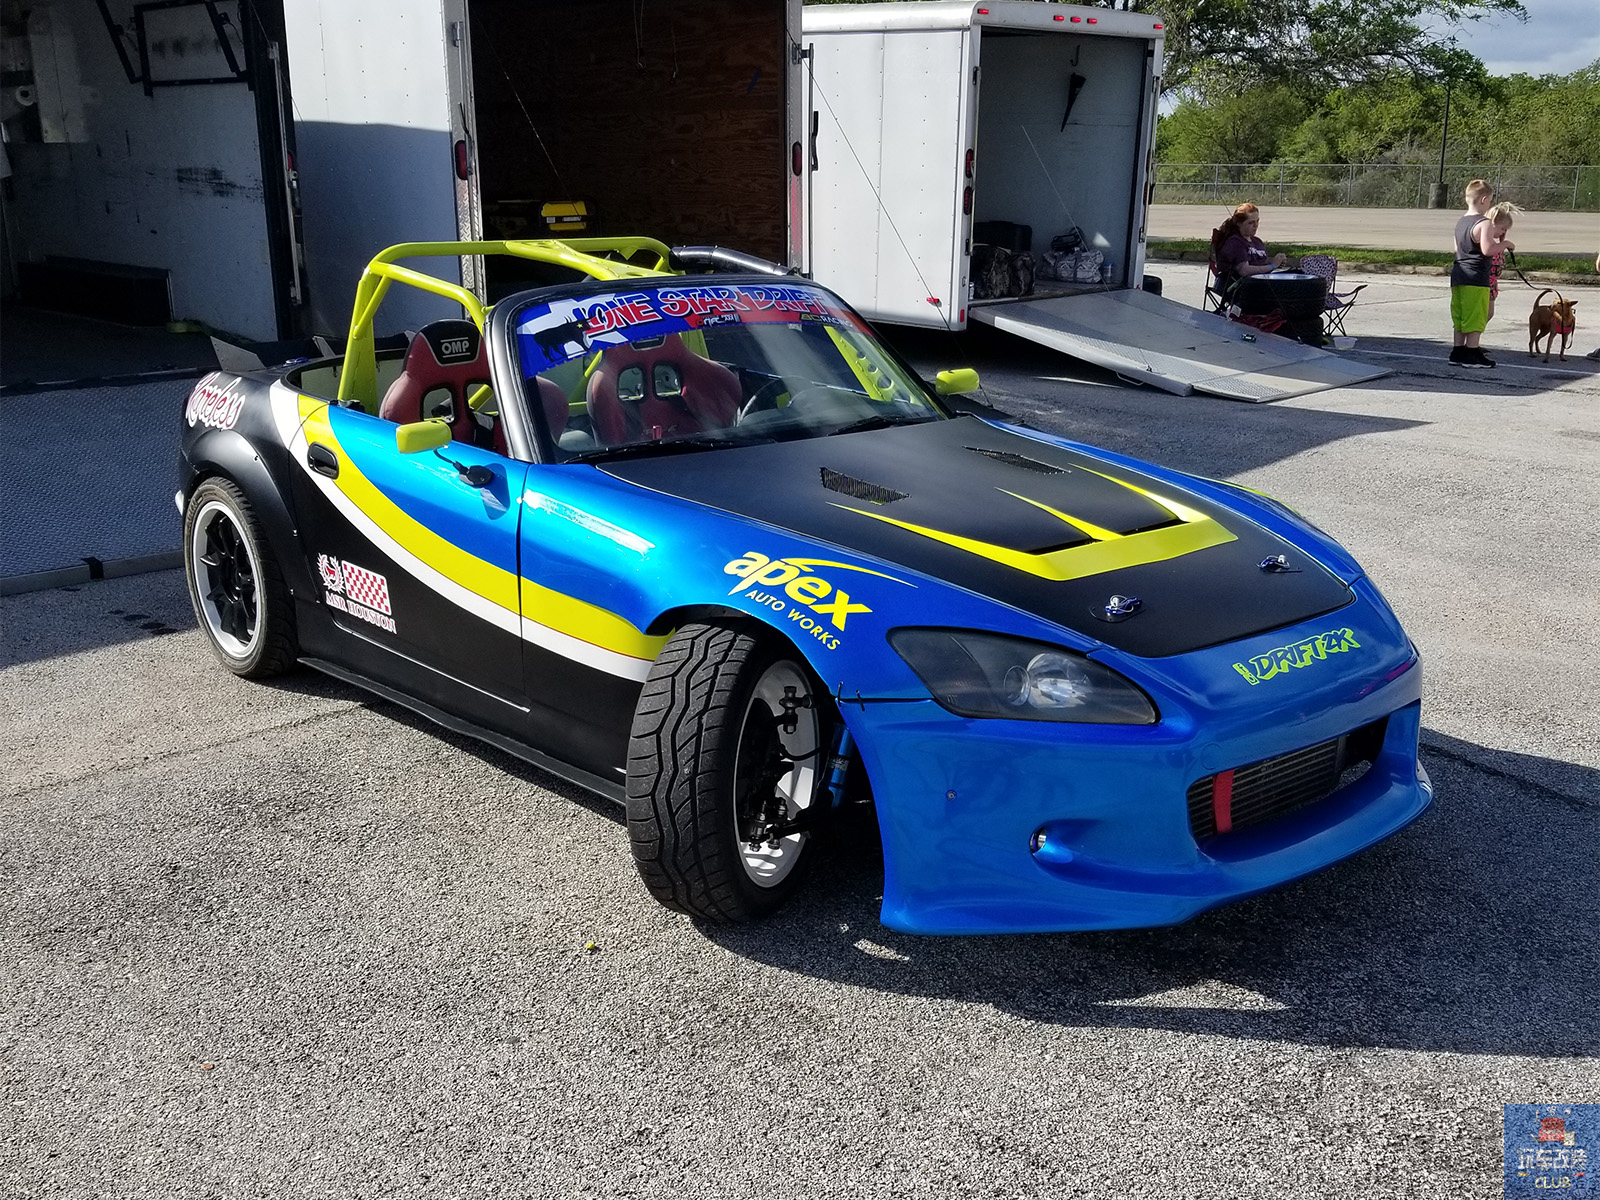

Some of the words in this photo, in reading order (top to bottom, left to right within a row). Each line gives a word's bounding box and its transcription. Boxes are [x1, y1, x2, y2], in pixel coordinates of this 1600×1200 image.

[572, 293, 663, 335] LONE
[657, 286, 751, 317] STAR
[735, 286, 829, 315] DRIFT
[441, 340, 470, 354] OMP
[325, 591, 348, 612] MSR
[346, 600, 397, 634] HOUSTON
[723, 551, 873, 632] apex
[745, 589, 786, 611] AUTO
[787, 608, 841, 650] WORKS
